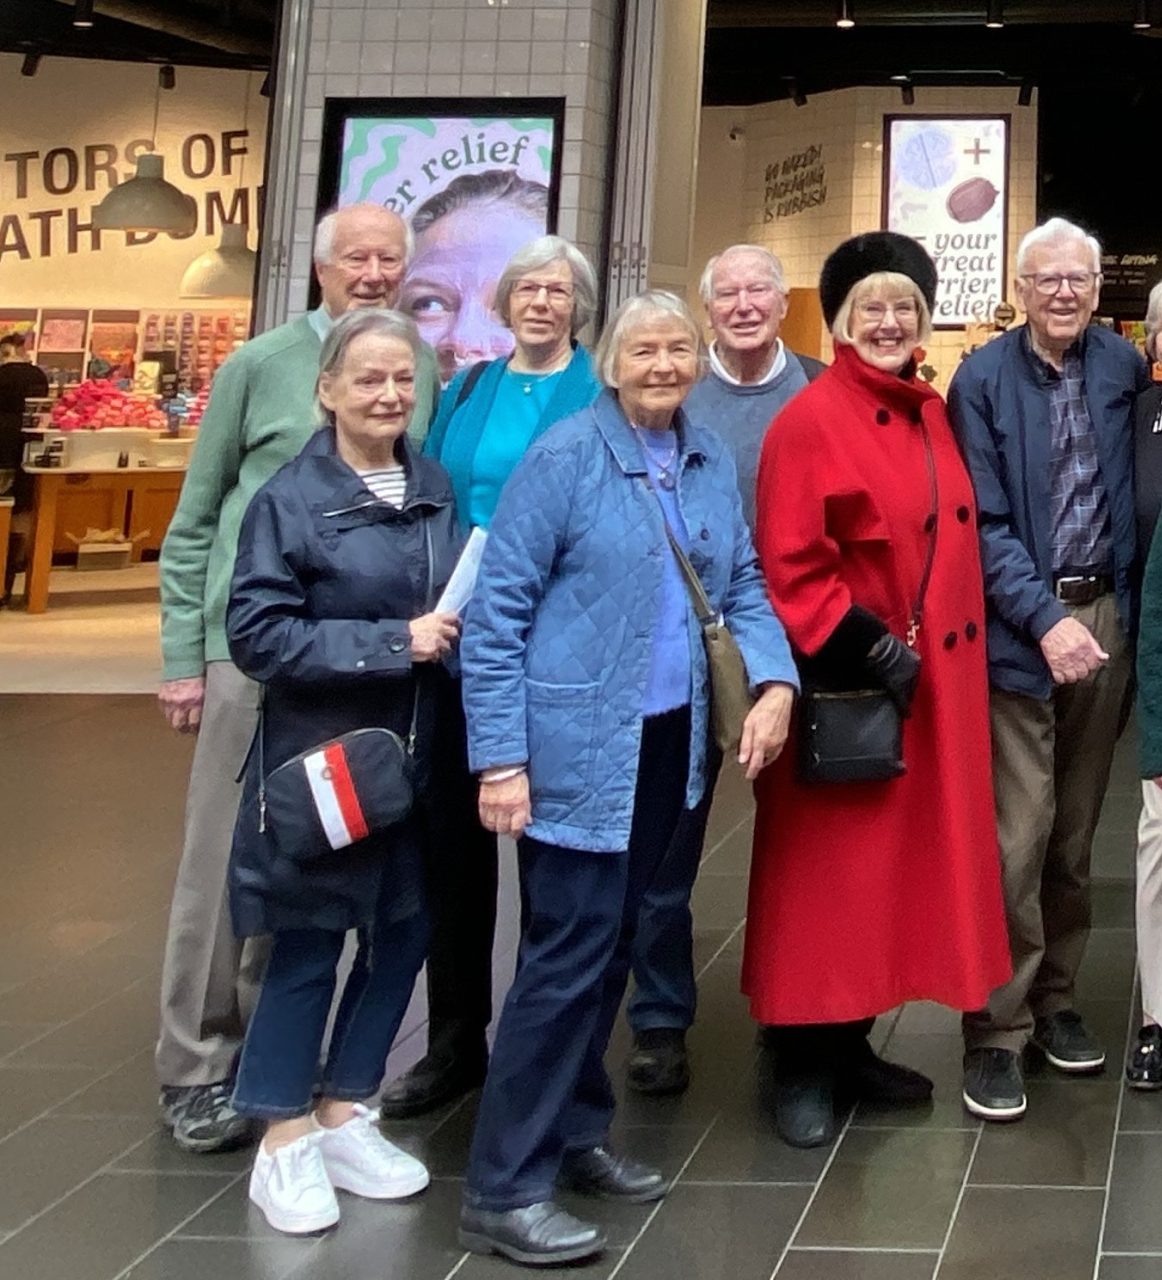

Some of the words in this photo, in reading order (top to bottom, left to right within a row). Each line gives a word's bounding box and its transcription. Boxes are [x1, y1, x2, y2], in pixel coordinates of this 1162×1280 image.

[182, 130, 249, 179] OF
[421, 132, 530, 184] relief
[933, 233, 997, 256] your
[934, 252, 996, 272] reat
[935, 294, 997, 319] elief
